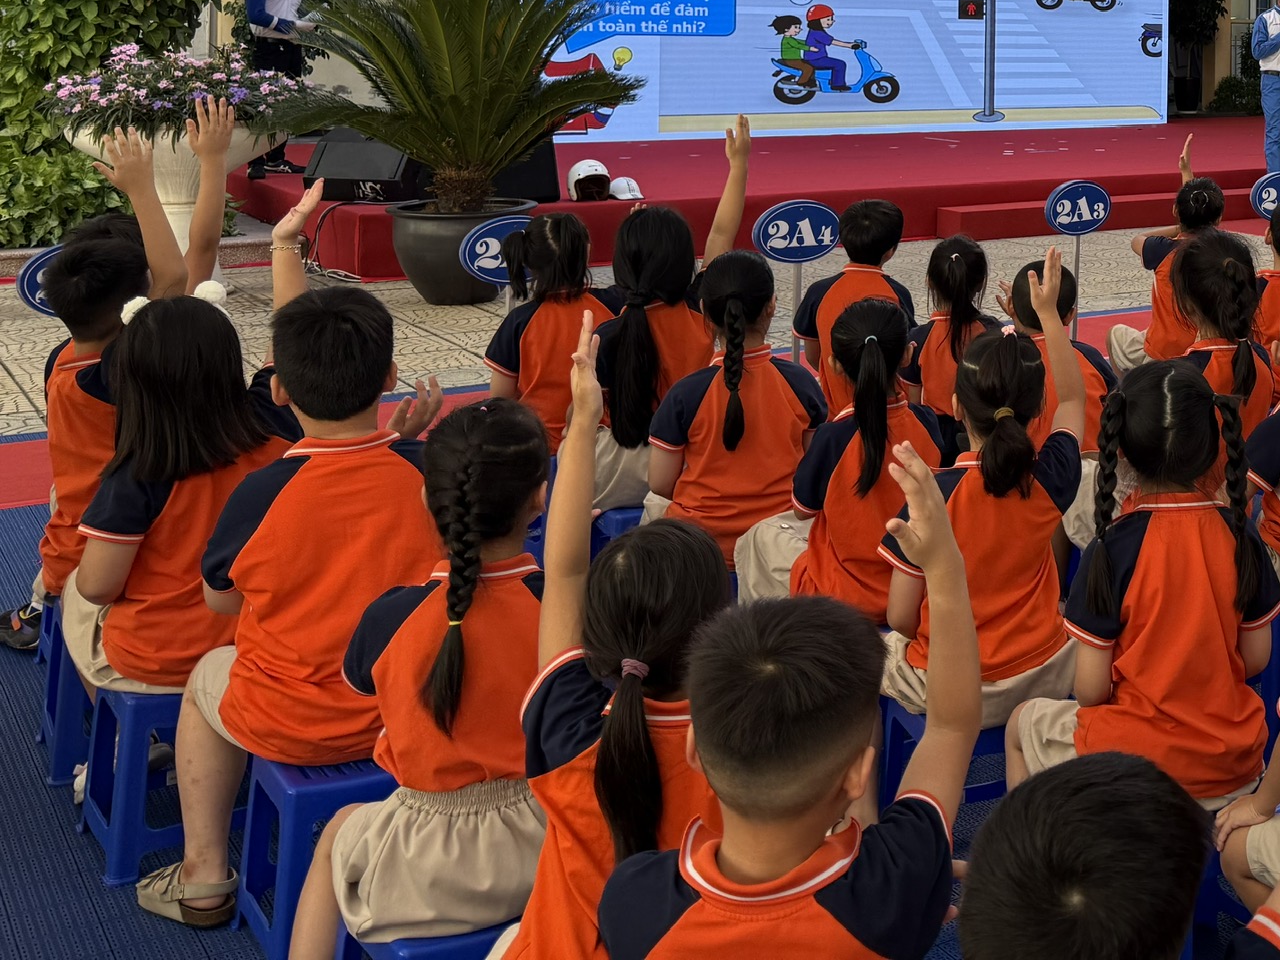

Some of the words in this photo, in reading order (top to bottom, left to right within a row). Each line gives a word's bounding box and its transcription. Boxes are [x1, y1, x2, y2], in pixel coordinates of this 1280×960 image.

[650, 2, 670, 16] để
[674, 3, 709, 17] đảm
[598, 18, 636, 32] toàn
[641, 20, 668, 33] thế
[672, 21, 705, 34] nhi?
[1056, 196, 1105, 225] 2A3
[767, 217, 834, 249] 2A4
